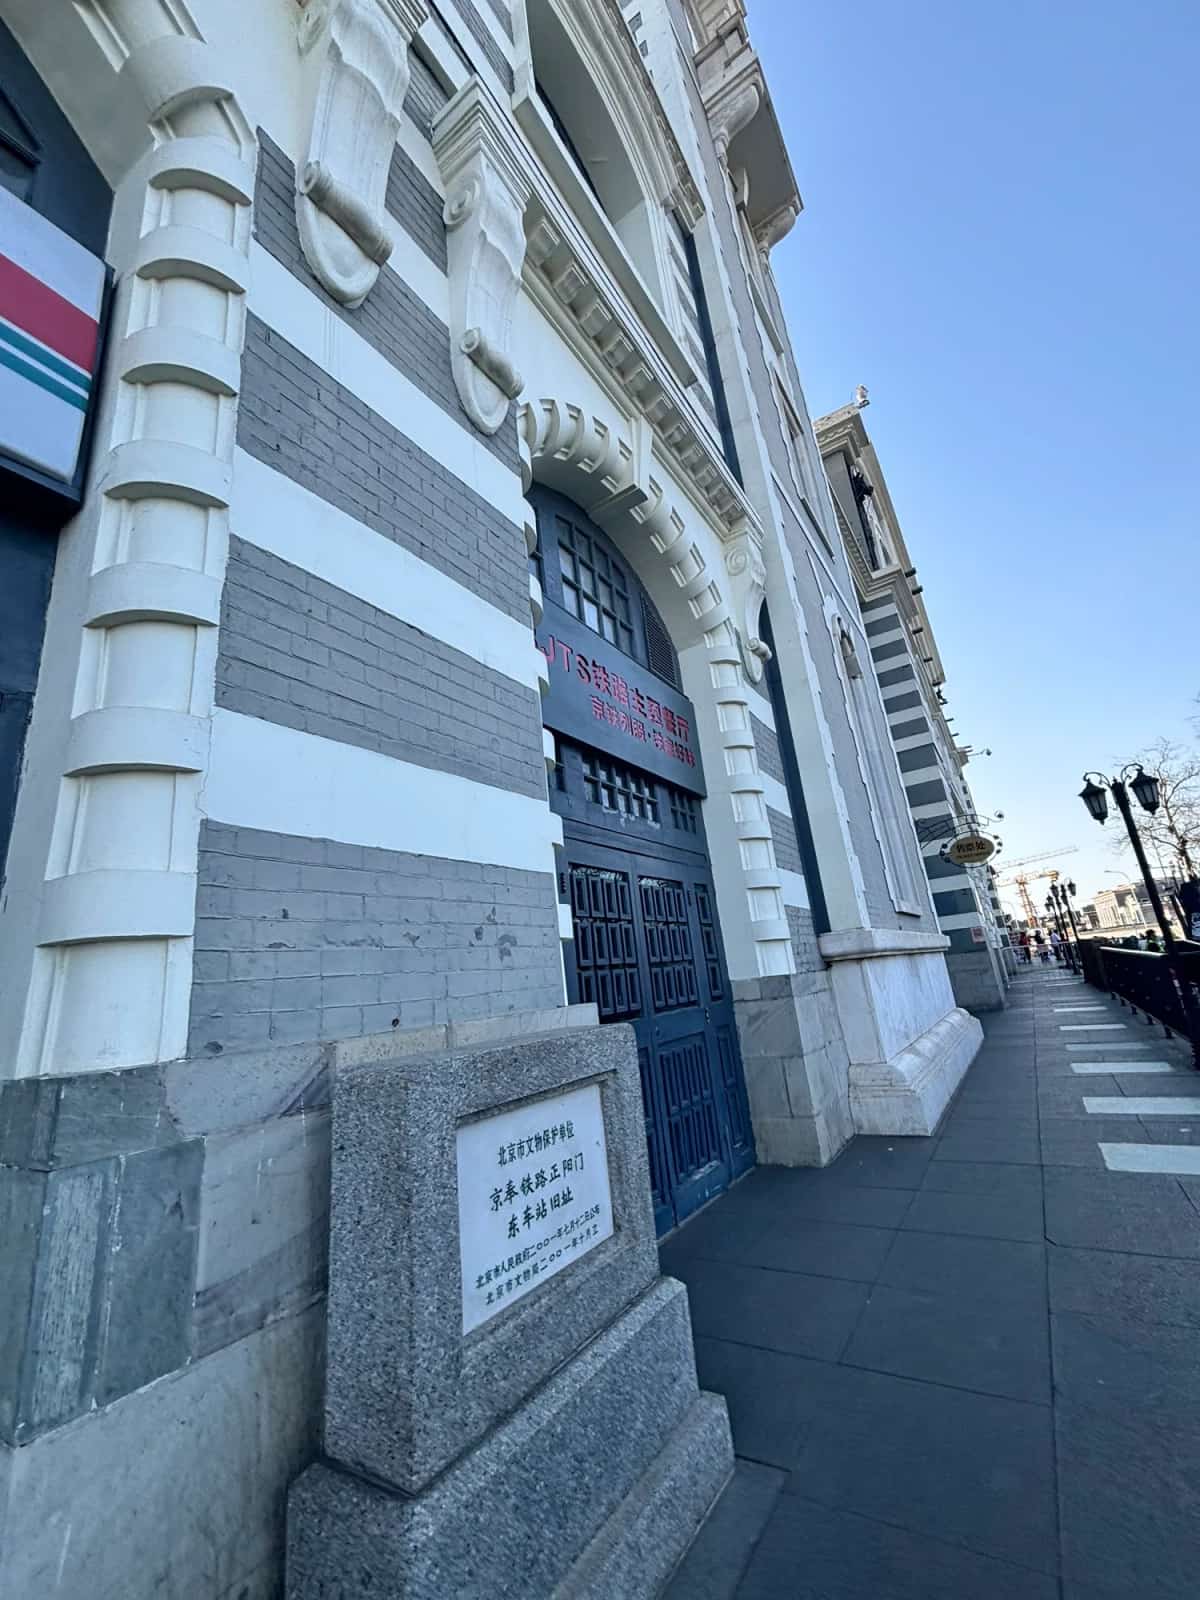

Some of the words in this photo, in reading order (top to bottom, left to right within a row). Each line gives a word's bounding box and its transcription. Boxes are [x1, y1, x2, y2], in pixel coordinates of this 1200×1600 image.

[498, 1120, 575, 1167] 北京市文物保护单位
[490, 1152, 585, 1212] 京奉铁路正阳门
[508, 1186, 575, 1239] 东车站旧址
